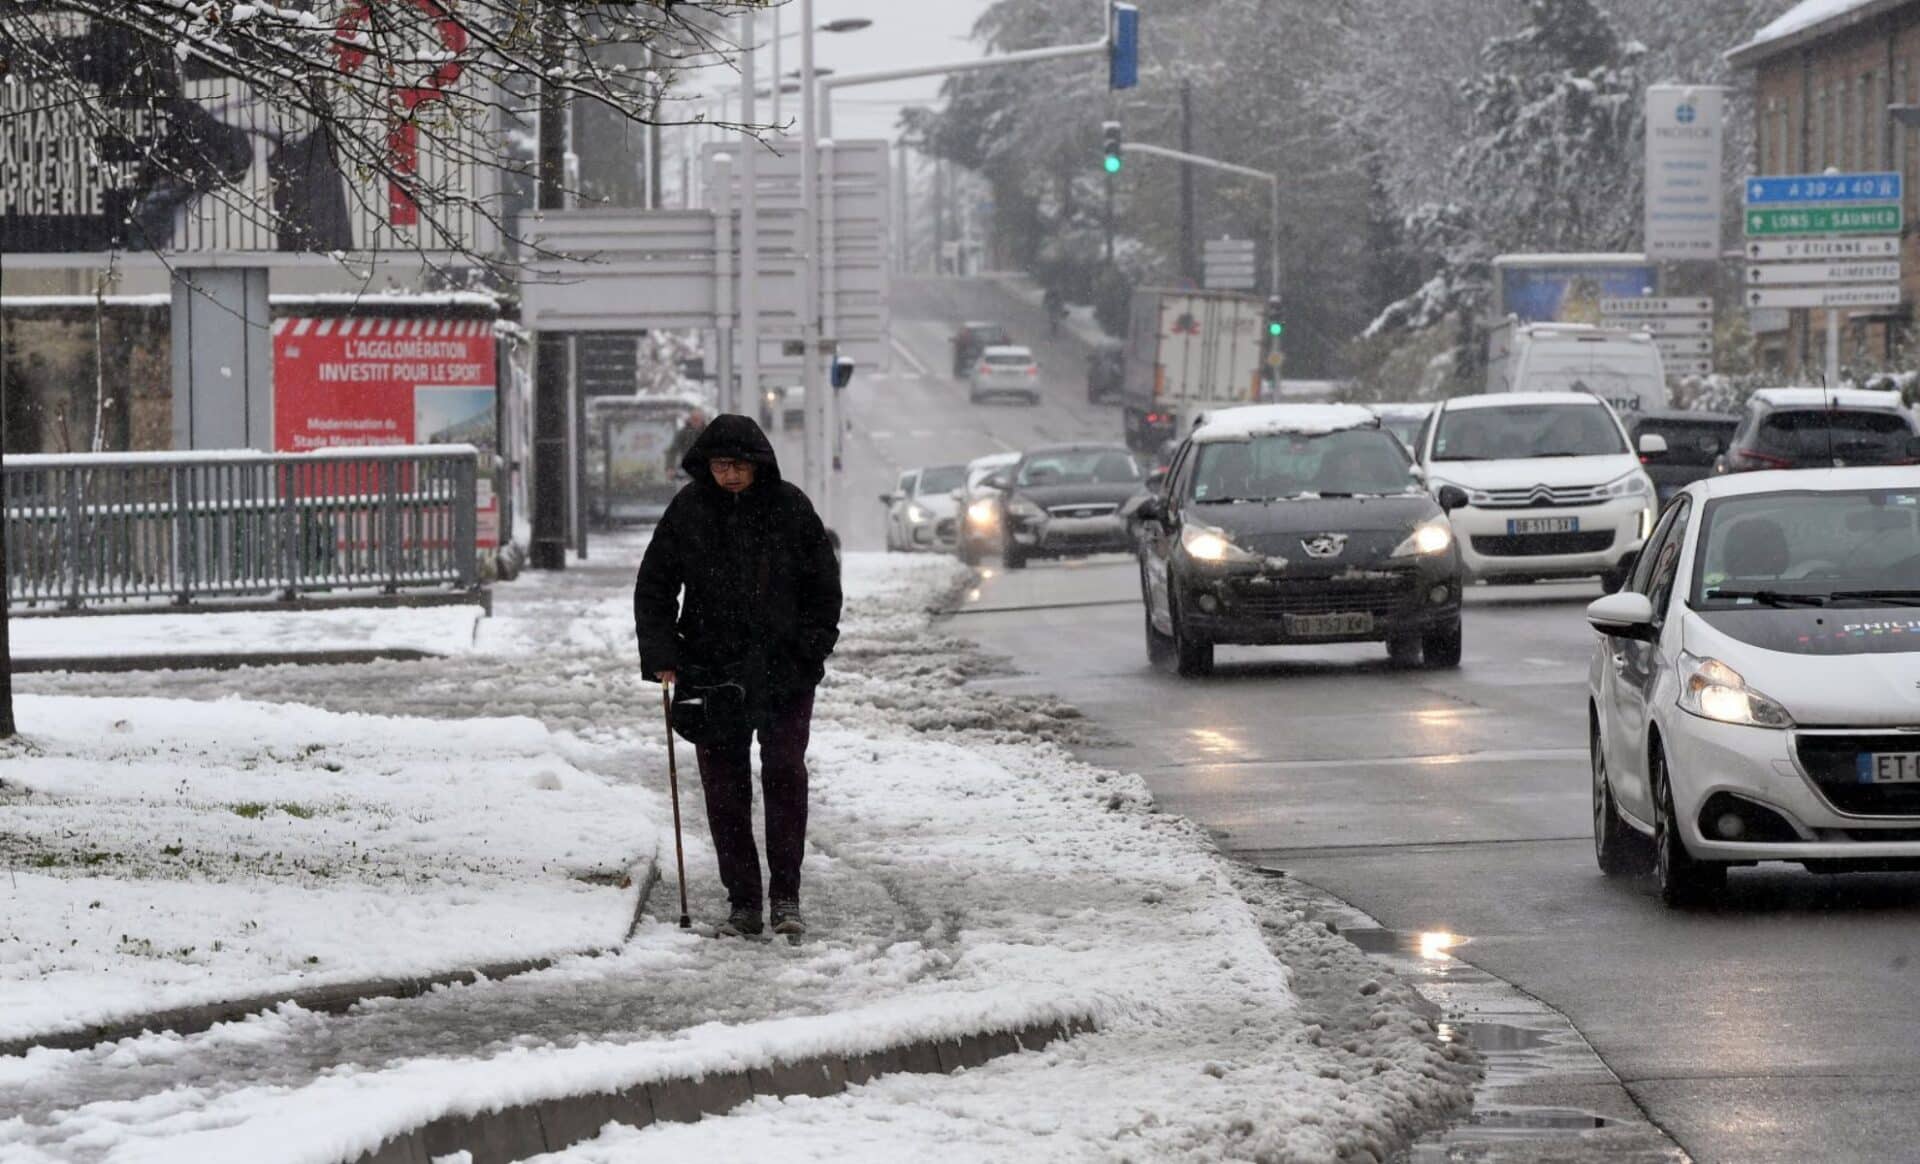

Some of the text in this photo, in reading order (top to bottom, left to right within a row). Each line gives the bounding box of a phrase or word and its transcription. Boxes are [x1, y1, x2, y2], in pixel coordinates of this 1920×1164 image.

[1771, 214, 1809, 228] LONS
[1831, 211, 1896, 227] SAUNIER
[345, 335, 467, 358] L'AGGLOMÉRATION
[319, 363, 481, 382] INVESTIT POUR LE SPORT
[307, 417, 384, 430] Modernisation
[1843, 620, 1920, 632] PHILI
